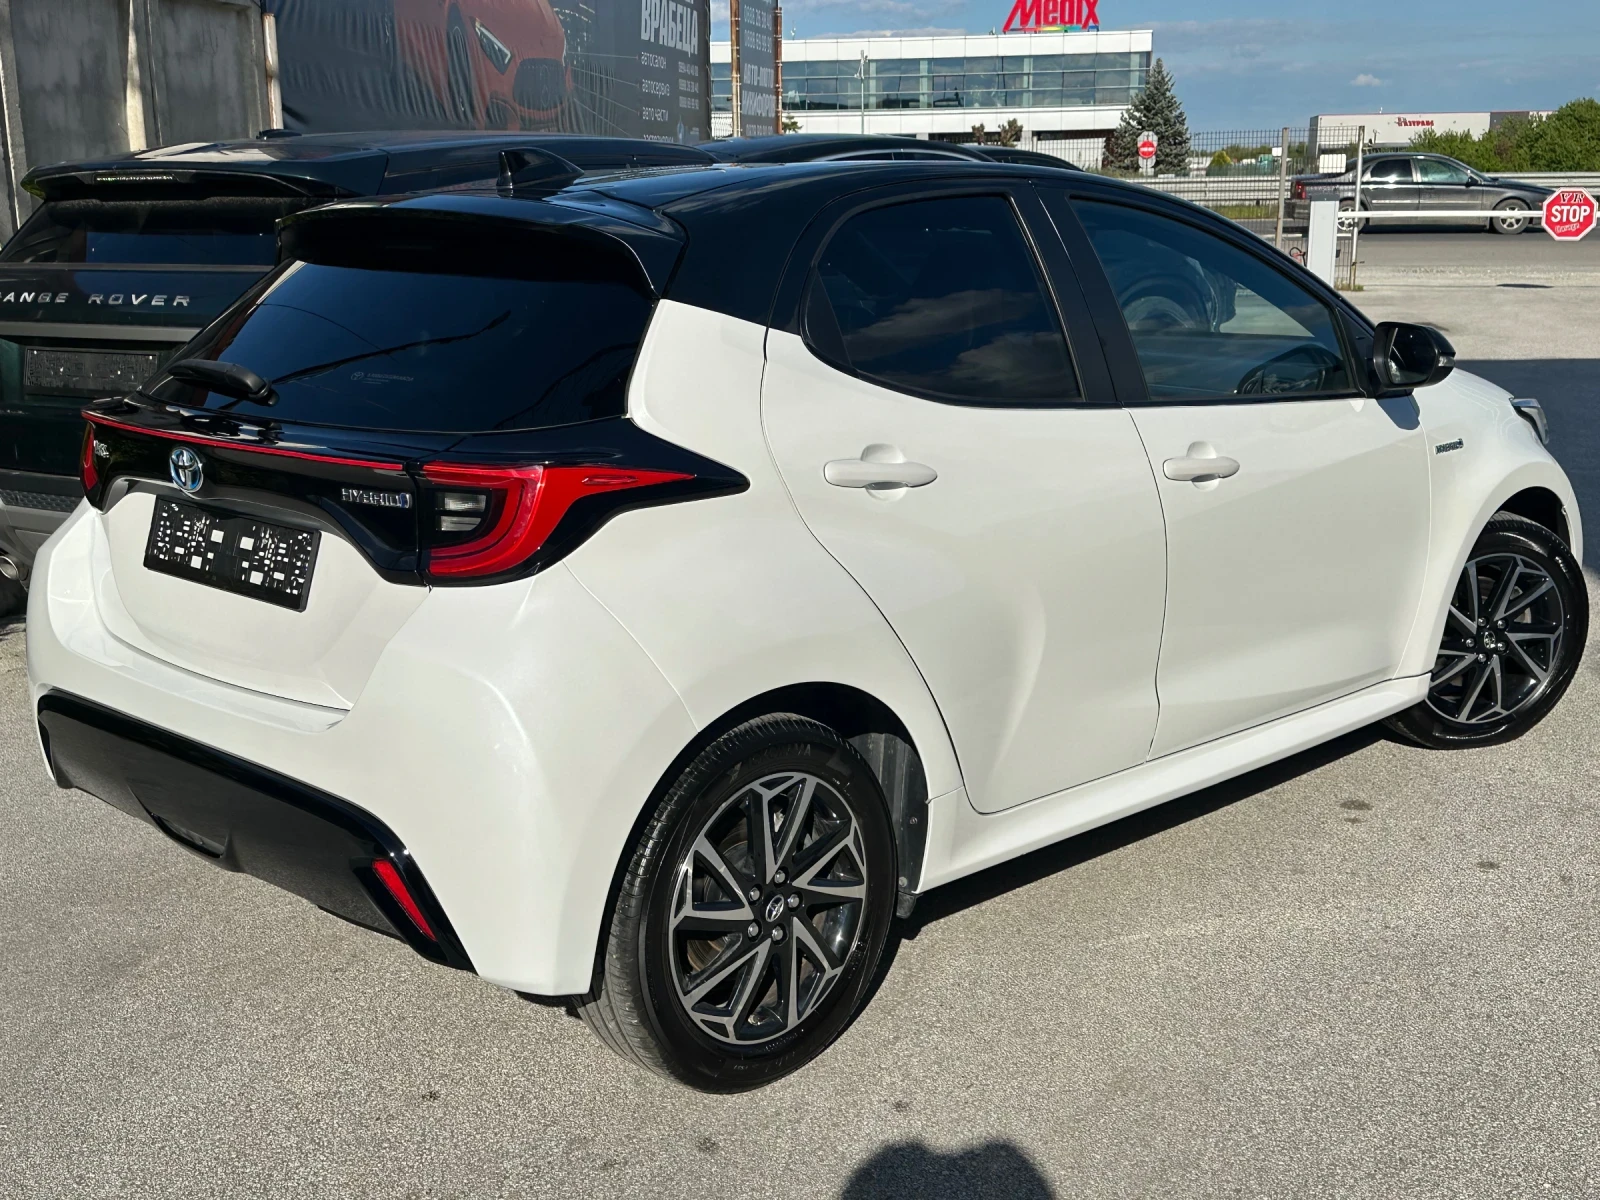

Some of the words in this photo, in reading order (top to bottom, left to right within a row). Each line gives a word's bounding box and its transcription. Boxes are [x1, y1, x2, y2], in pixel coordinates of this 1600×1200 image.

[1002, 0, 1100, 33] Medix
[641, 0, 699, 58] ВРАБЕЦА
[641, 51, 667, 69] автосалон
[642, 78, 670, 99] автосервиз
[1551, 205, 1591, 223] STOP
[0, 292, 69, 304] ANGE
[88, 293, 190, 307] ROVER
[342, 488, 412, 509] HYBRID
